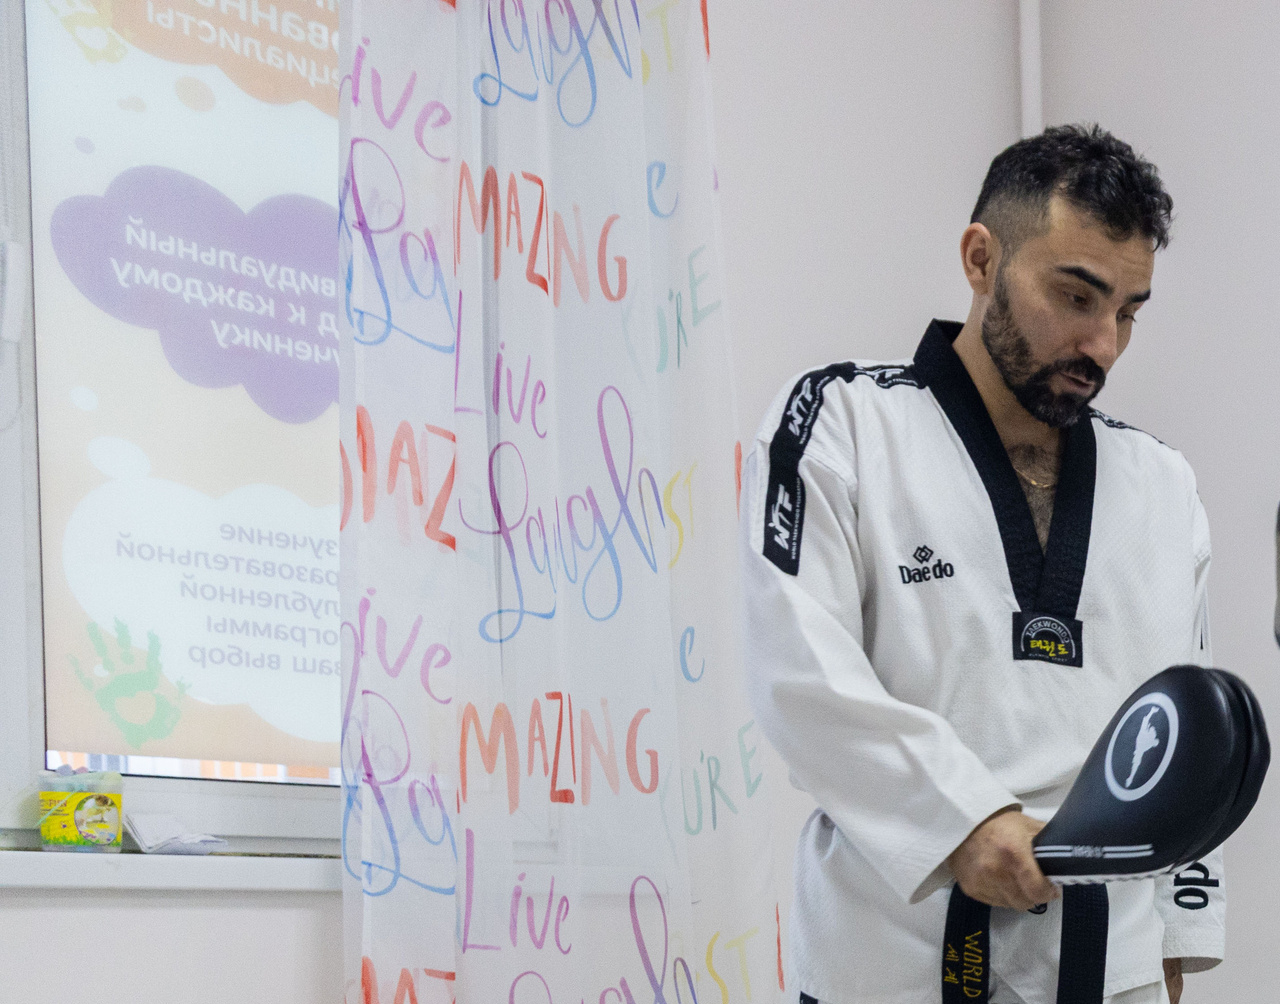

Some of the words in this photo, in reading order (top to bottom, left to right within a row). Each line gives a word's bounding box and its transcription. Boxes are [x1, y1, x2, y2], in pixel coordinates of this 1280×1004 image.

[768, 484, 793, 550] WTF
[1026, 620, 1070, 643] TAEKWONDO
[462, 828, 572, 955] Live
[962, 930, 983, 998] WORLD
